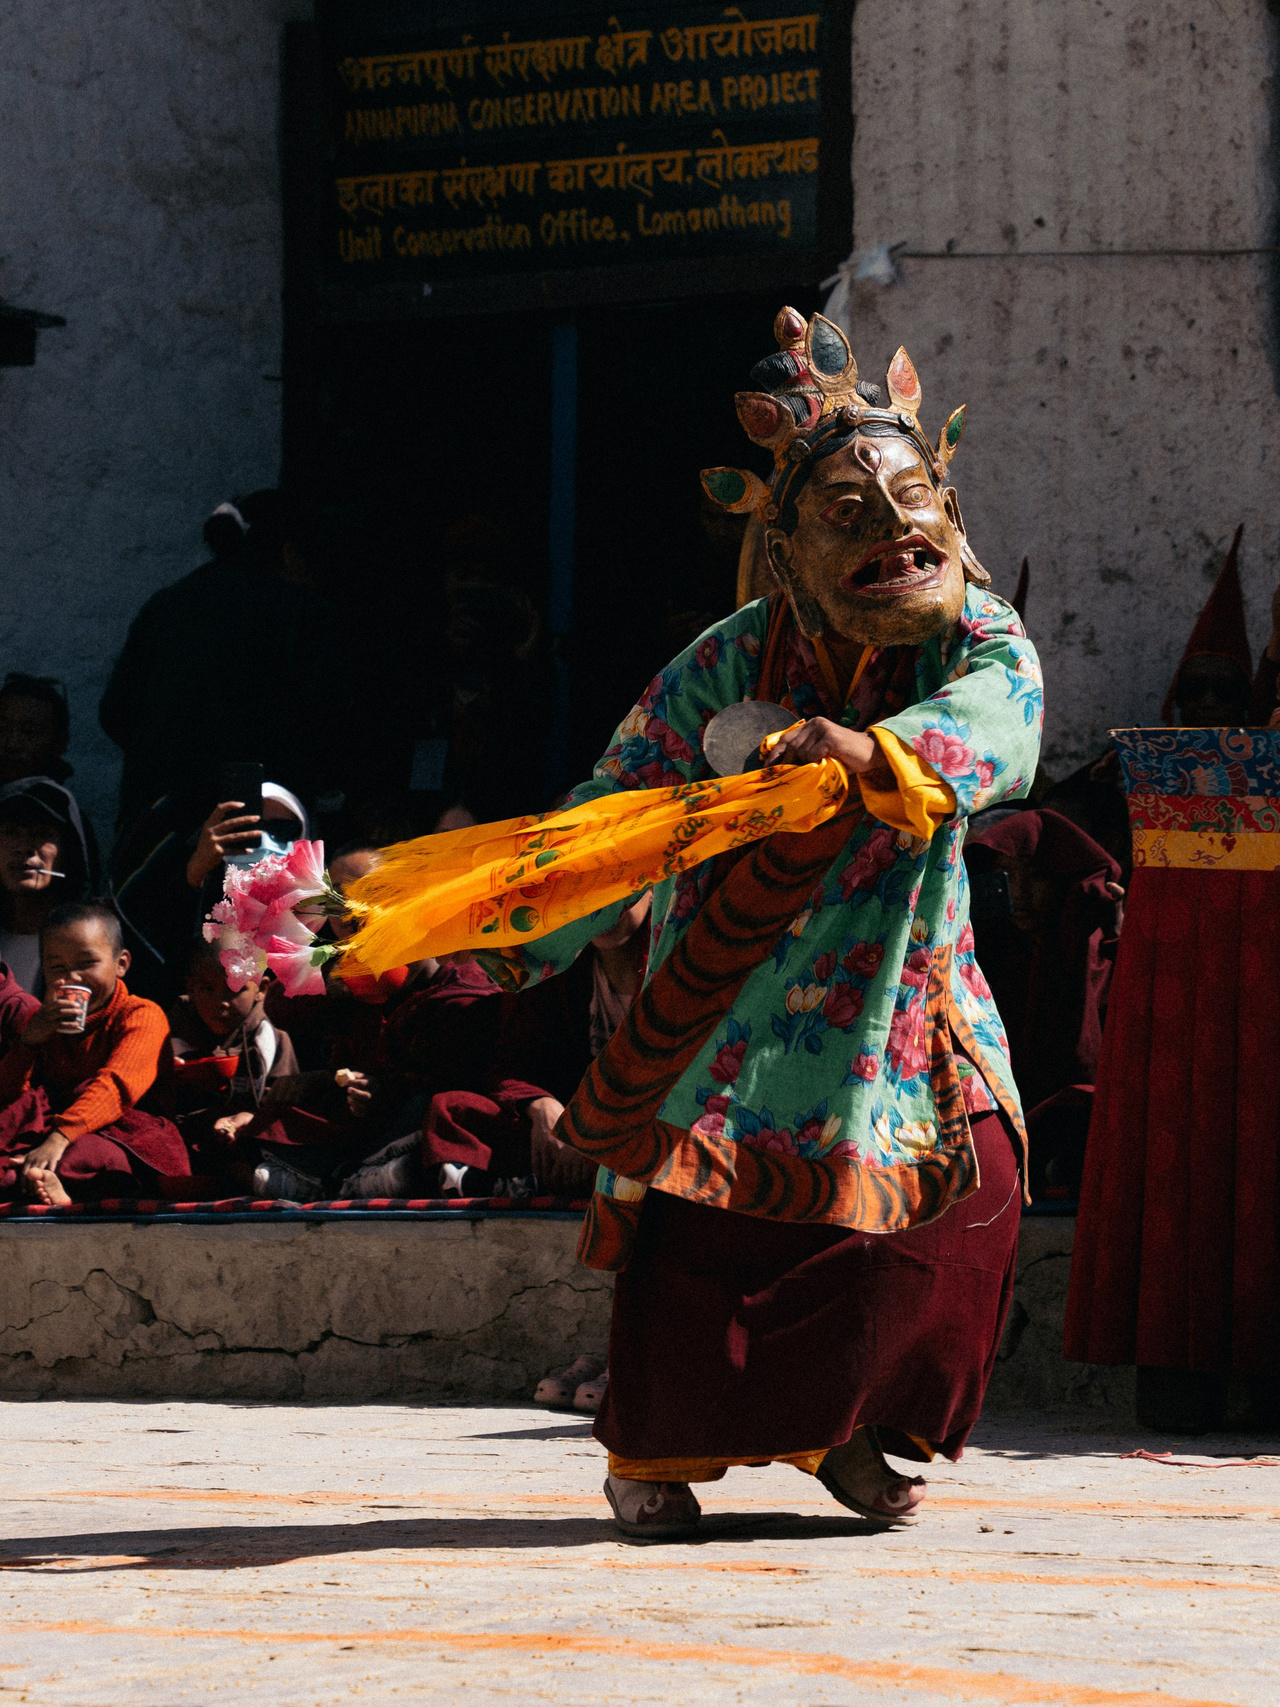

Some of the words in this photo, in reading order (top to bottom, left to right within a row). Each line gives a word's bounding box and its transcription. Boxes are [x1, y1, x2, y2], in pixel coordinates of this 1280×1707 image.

[484, 32, 592, 88] संरक्षण
[596, 16, 652, 78] क्षेत्र
[660, 7, 820, 61] आयोजना
[468, 83, 643, 131] CONSERVATION
[650, 78, 717, 118] AREA
[722, 68, 820, 111] PROJECT
[336, 169, 438, 222] इलाका
[441, 155, 541, 211] संरक्षण
[338, 226, 382, 264] Unit
[393, 213, 532, 258] Conservation
[636, 193, 792, 239] Lomanthang
